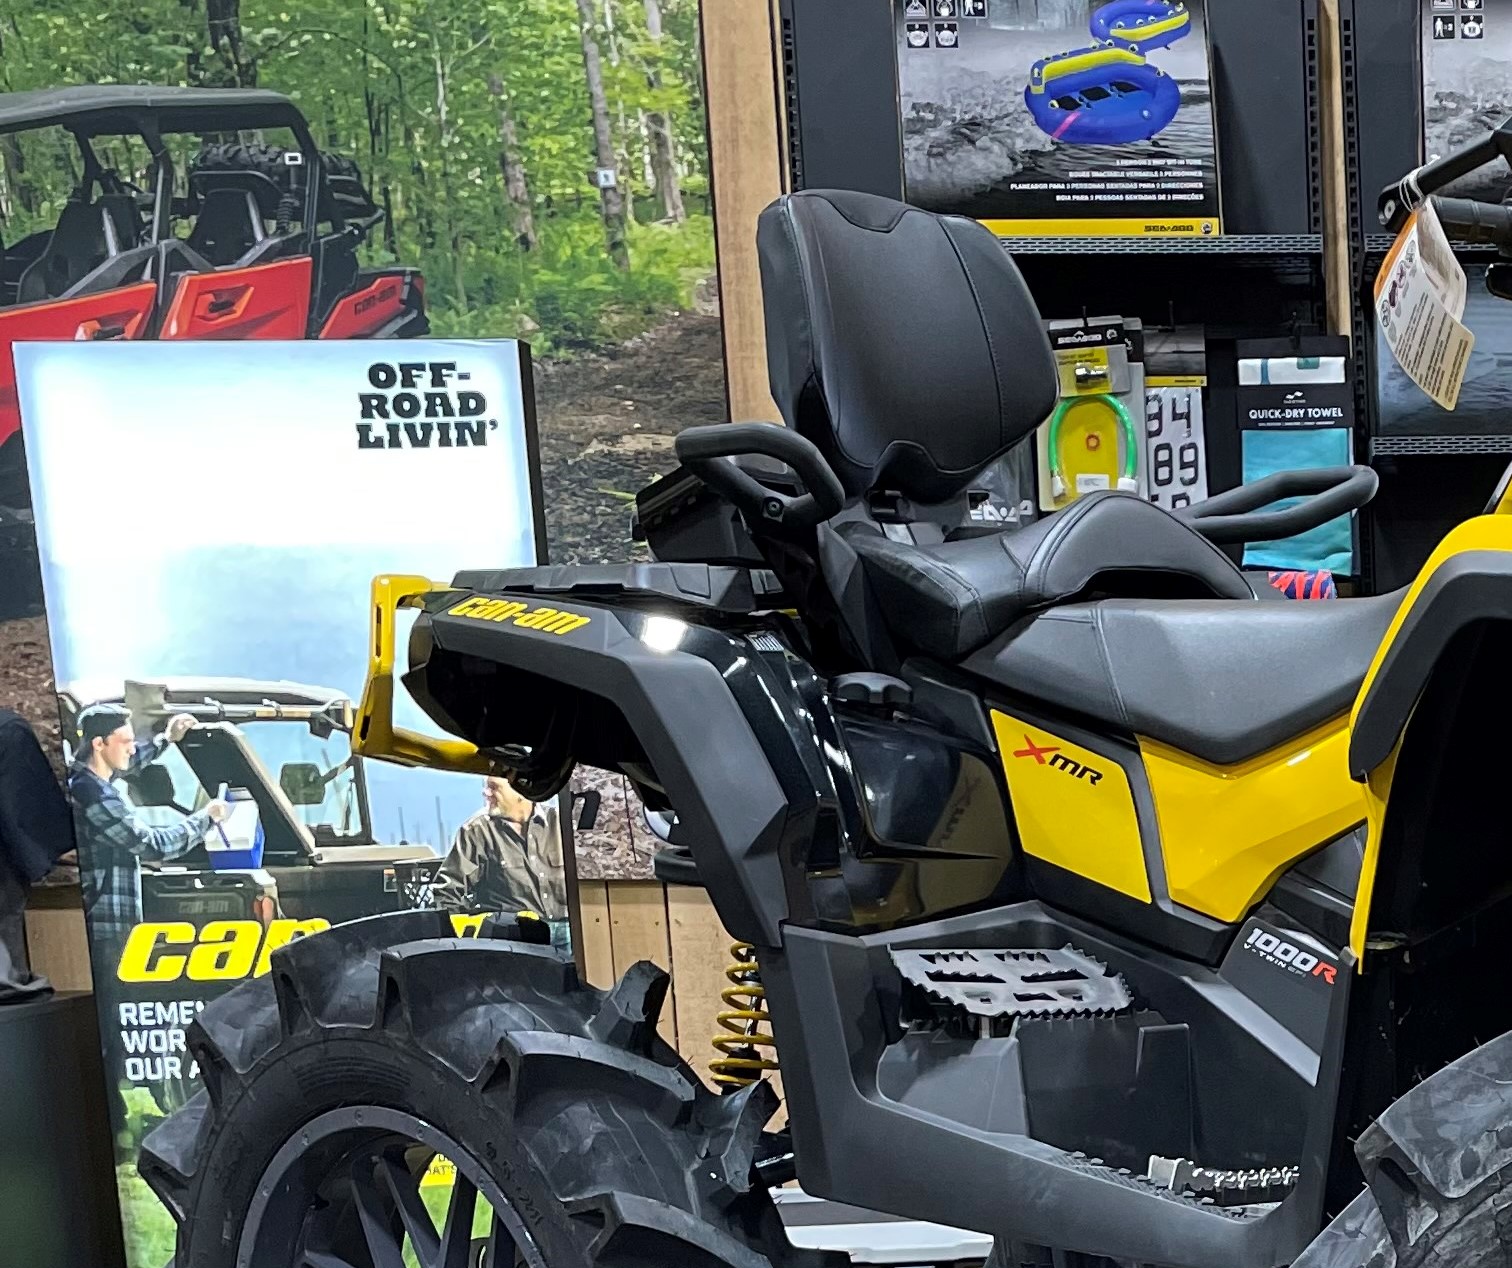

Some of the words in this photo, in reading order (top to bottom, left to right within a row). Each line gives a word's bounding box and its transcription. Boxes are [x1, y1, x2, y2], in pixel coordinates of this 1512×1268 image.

[367, 361, 471, 390] OFF-
[358, 391, 488, 420] ROAD
[1249, 408, 1306, 420] QUICK-DRY
[1306, 406, 1344, 418] TOWEL
[447, 597, 592, 635] can-am
[1246, 927, 1338, 985] 1000R
[121, 1028, 187, 1054] WOR
[125, 1056, 182, 1081] OUR
